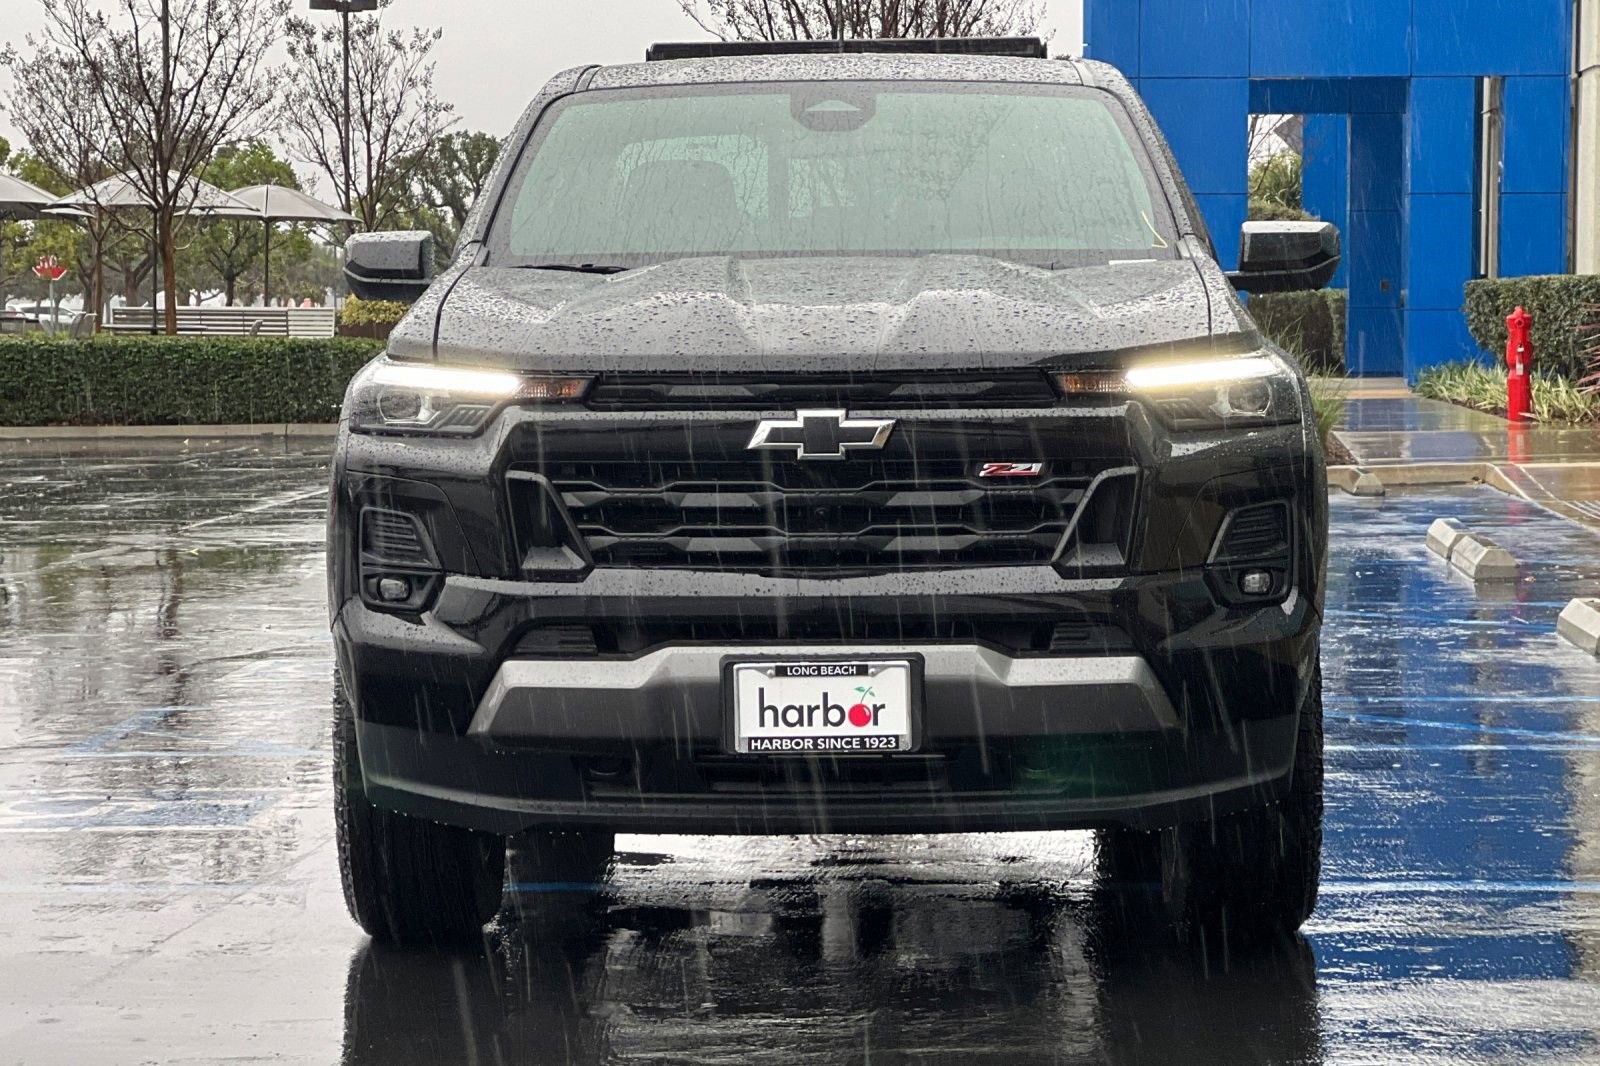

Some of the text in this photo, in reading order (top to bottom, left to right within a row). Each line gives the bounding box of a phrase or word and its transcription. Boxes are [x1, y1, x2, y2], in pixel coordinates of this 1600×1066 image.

[979, 463, 1043, 477] Z71
[787, 665, 857, 676] LONG BEACH
[758, 687, 886, 728] harbor
[751, 737, 897, 750] HARBOR SINCE 1923
